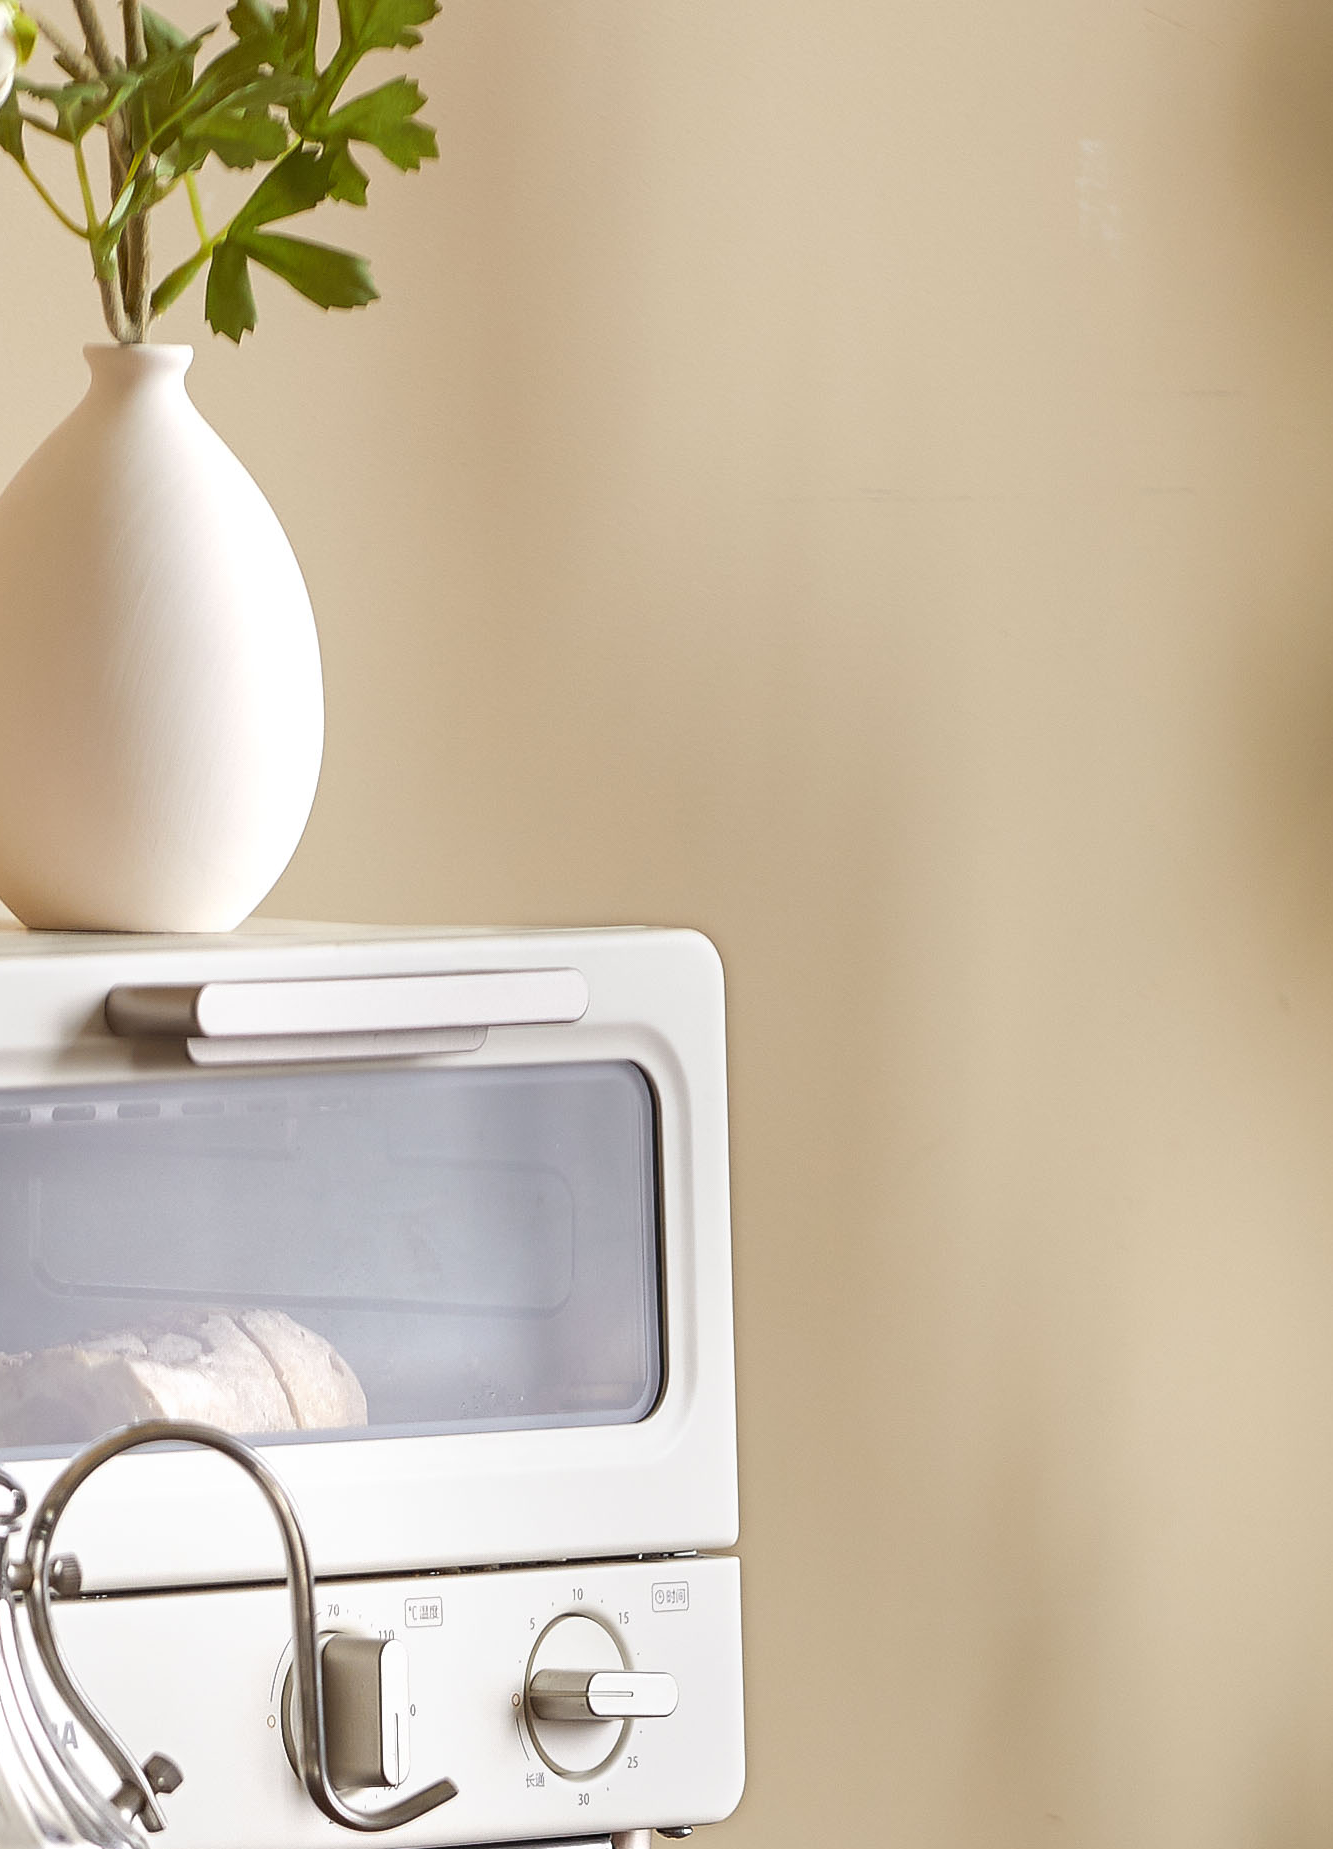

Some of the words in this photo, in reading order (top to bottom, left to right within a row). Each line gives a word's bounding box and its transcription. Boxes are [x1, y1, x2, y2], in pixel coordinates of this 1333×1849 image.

[572, 1588, 583, 1600] 10
[327, 1604, 339, 1617] 70
[529, 1617, 535, 1631] 5
[618, 1612, 629, 1625] 15
[627, 1756, 638, 1769] 25
[525, 1772, 545, 1788] 长通
[578, 1792, 590, 1806] 30
